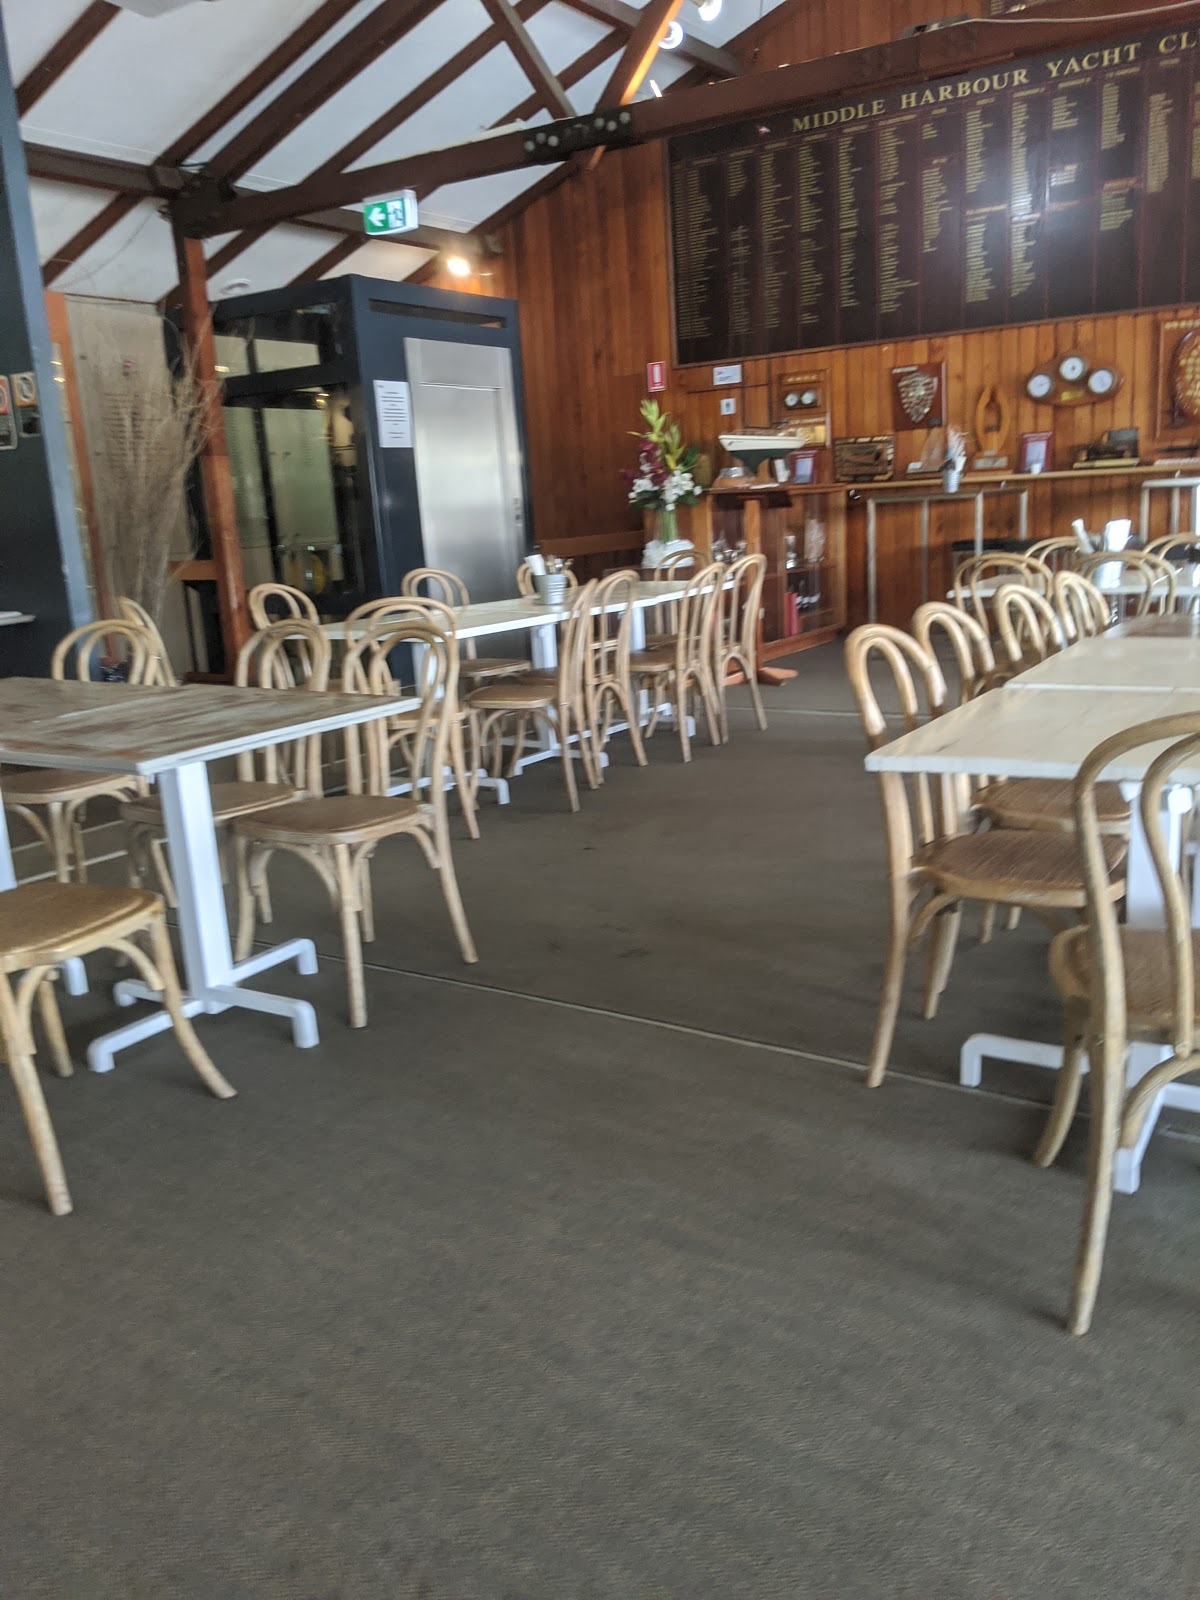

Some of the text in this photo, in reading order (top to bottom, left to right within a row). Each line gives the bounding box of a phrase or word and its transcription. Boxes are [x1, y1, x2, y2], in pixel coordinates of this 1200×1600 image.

[792, 30, 1198, 132] MIDDLE HARBOUR YACHT CL
